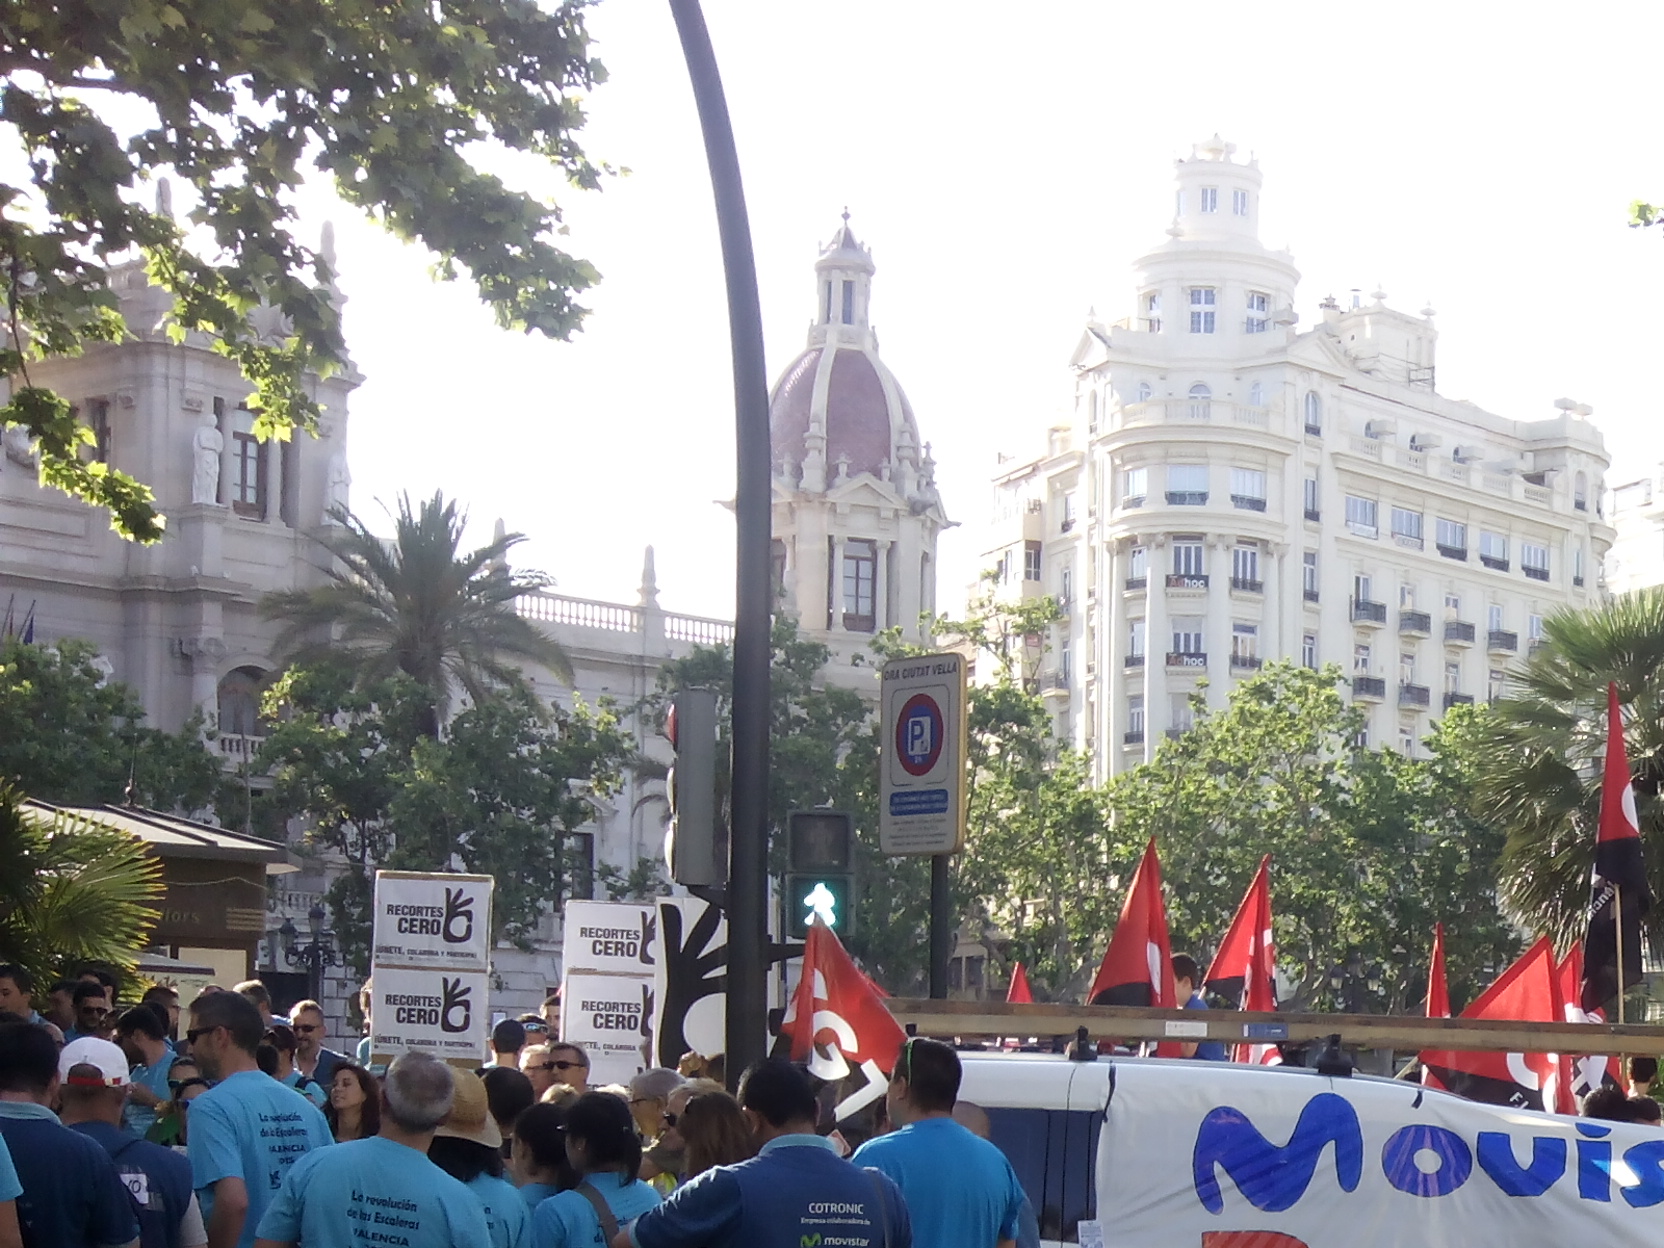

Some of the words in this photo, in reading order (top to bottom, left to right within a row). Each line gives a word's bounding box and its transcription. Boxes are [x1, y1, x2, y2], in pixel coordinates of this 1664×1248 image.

[902, 666, 930, 679] CIUTAT
[932, 662, 957, 676] VELLA
[386, 904, 444, 918] RECORTES
[397, 917, 441, 935] CERO
[580, 927, 640, 941] RECORTES
[592, 940, 638, 957] CERO
[385, 994, 442, 1008] RECORTES
[581, 1001, 641, 1014] RECORTES
[395, 1007, 439, 1025] CERO
[592, 1013, 639, 1031] CERO
[808, 1202, 864, 1214] COTRONIC
[374, 1212, 420, 1230] Escaleras
[824, 1237, 869, 1247] movistar
